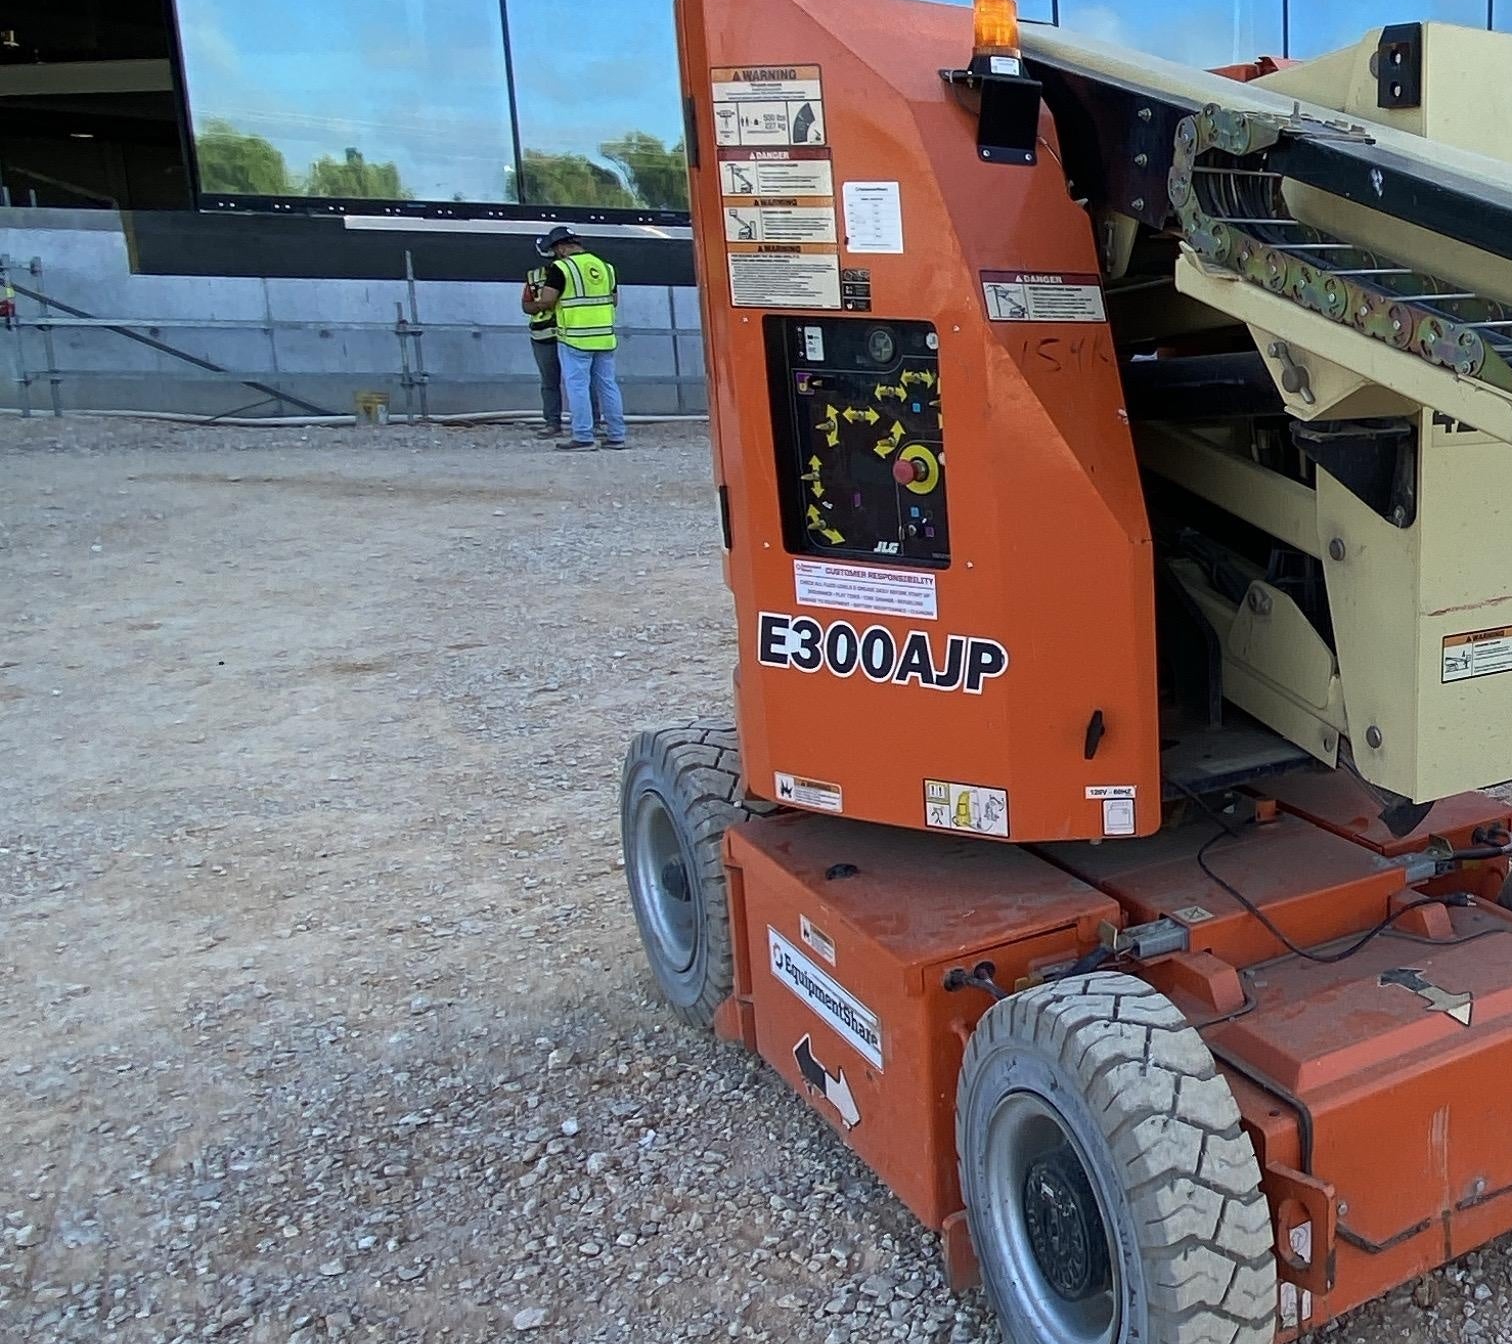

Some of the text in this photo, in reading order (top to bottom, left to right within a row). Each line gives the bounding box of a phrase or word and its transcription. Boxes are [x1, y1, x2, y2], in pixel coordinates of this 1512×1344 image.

[742, 69, 797, 81] WARNING
[1023, 275, 1062, 284] DANGER
[873, 541, 900, 554] JLG
[825, 567, 867, 578] CUSTOMER
[868, 571, 934, 585] RESPONSIBILITY
[758, 611, 1009, 695] E300AJP
[784, 952, 878, 1046] EquipmentShare
